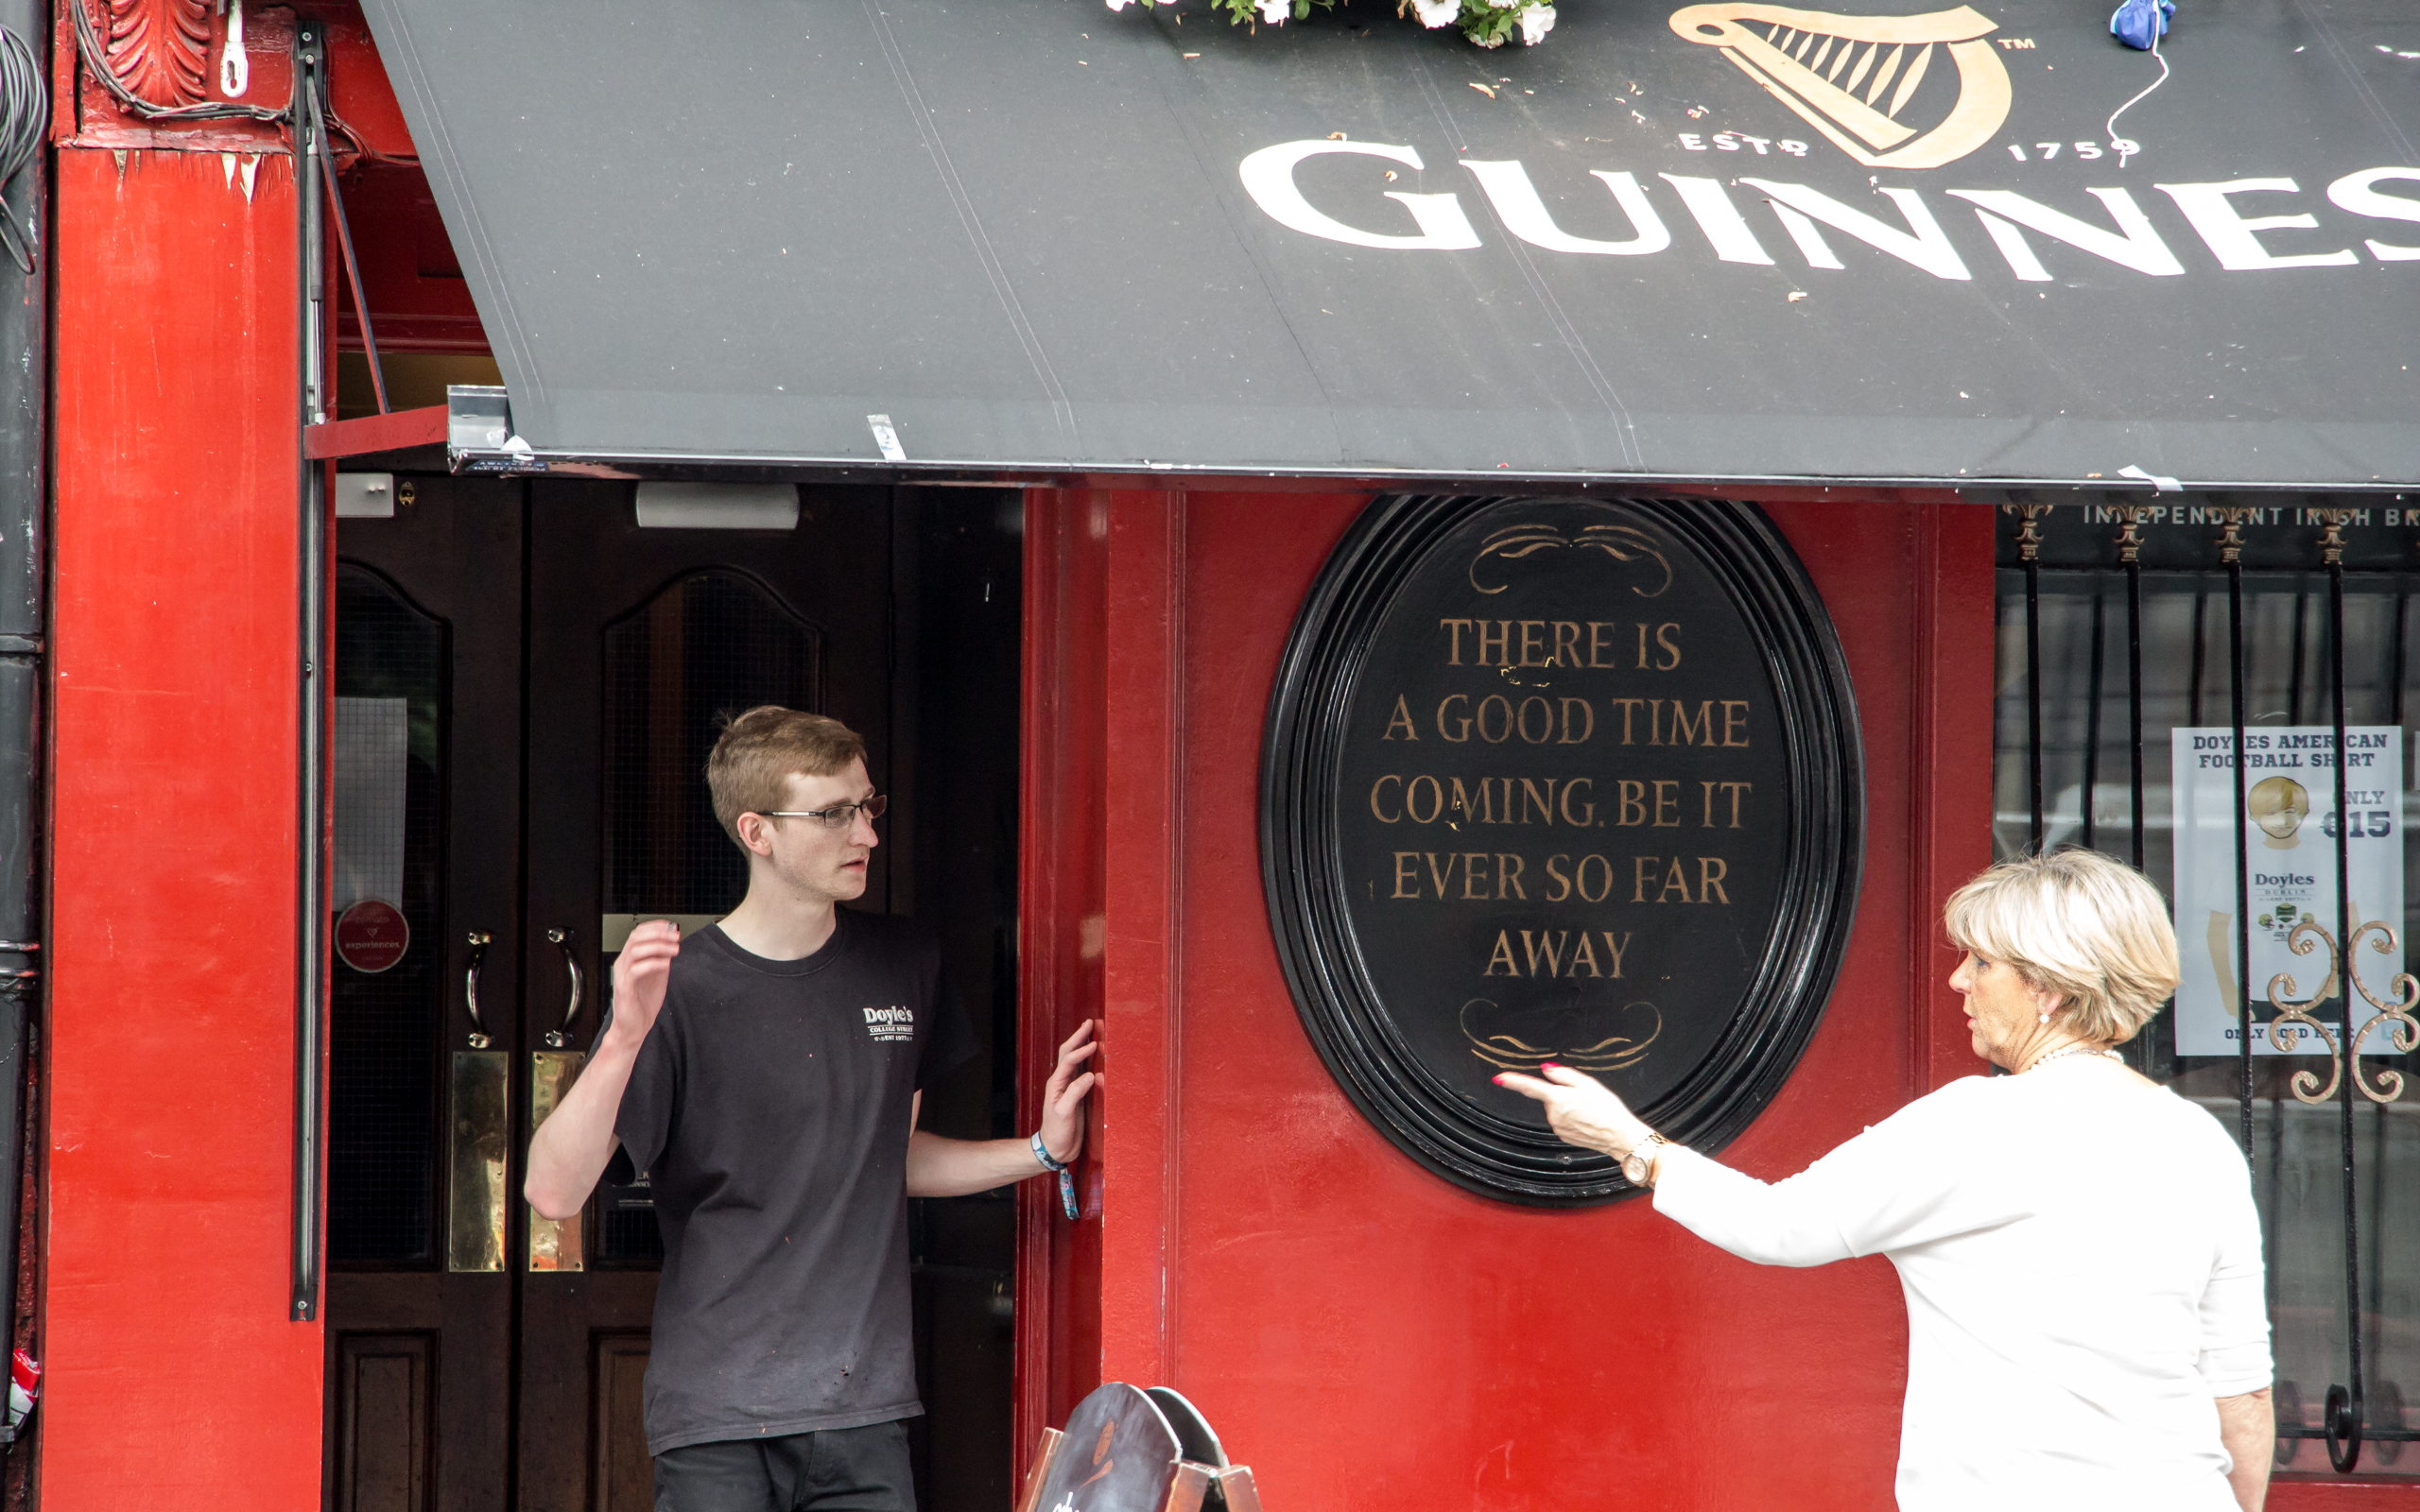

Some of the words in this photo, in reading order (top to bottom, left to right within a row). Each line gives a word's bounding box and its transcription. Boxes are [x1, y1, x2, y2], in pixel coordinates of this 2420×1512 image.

[1996, 39, 2036, 50] TM
[1677, 132, 1809, 158] ESTD
[2007, 138, 2141, 162] 1759
[1440, 617, 1616, 669] THERE
[1634, 622, 1682, 671] IS
[1381, 693, 1419, 741] A
[1436, 693, 1595, 745] GOOD
[1612, 697, 1750, 747] TIME
[2193, 734, 2271, 750] DOYES
[2277, 733, 2388, 749] AMERCAN
[2310, 752, 2376, 767] SHRT
[1616, 779, 1682, 829] BE
[1699, 781, 1753, 830] IT
[2333, 790, 2385, 805] NLY
[1390, 850, 1528, 901] EVER
[1545, 853, 1614, 902] SO
[1630, 855, 1731, 904] FAR
[2255, 873, 2315, 888] Doyles
[345, 940, 400, 950] experiences
[1482, 928, 1634, 980] AWAY
[862, 1005, 913, 1025] Doyle's
